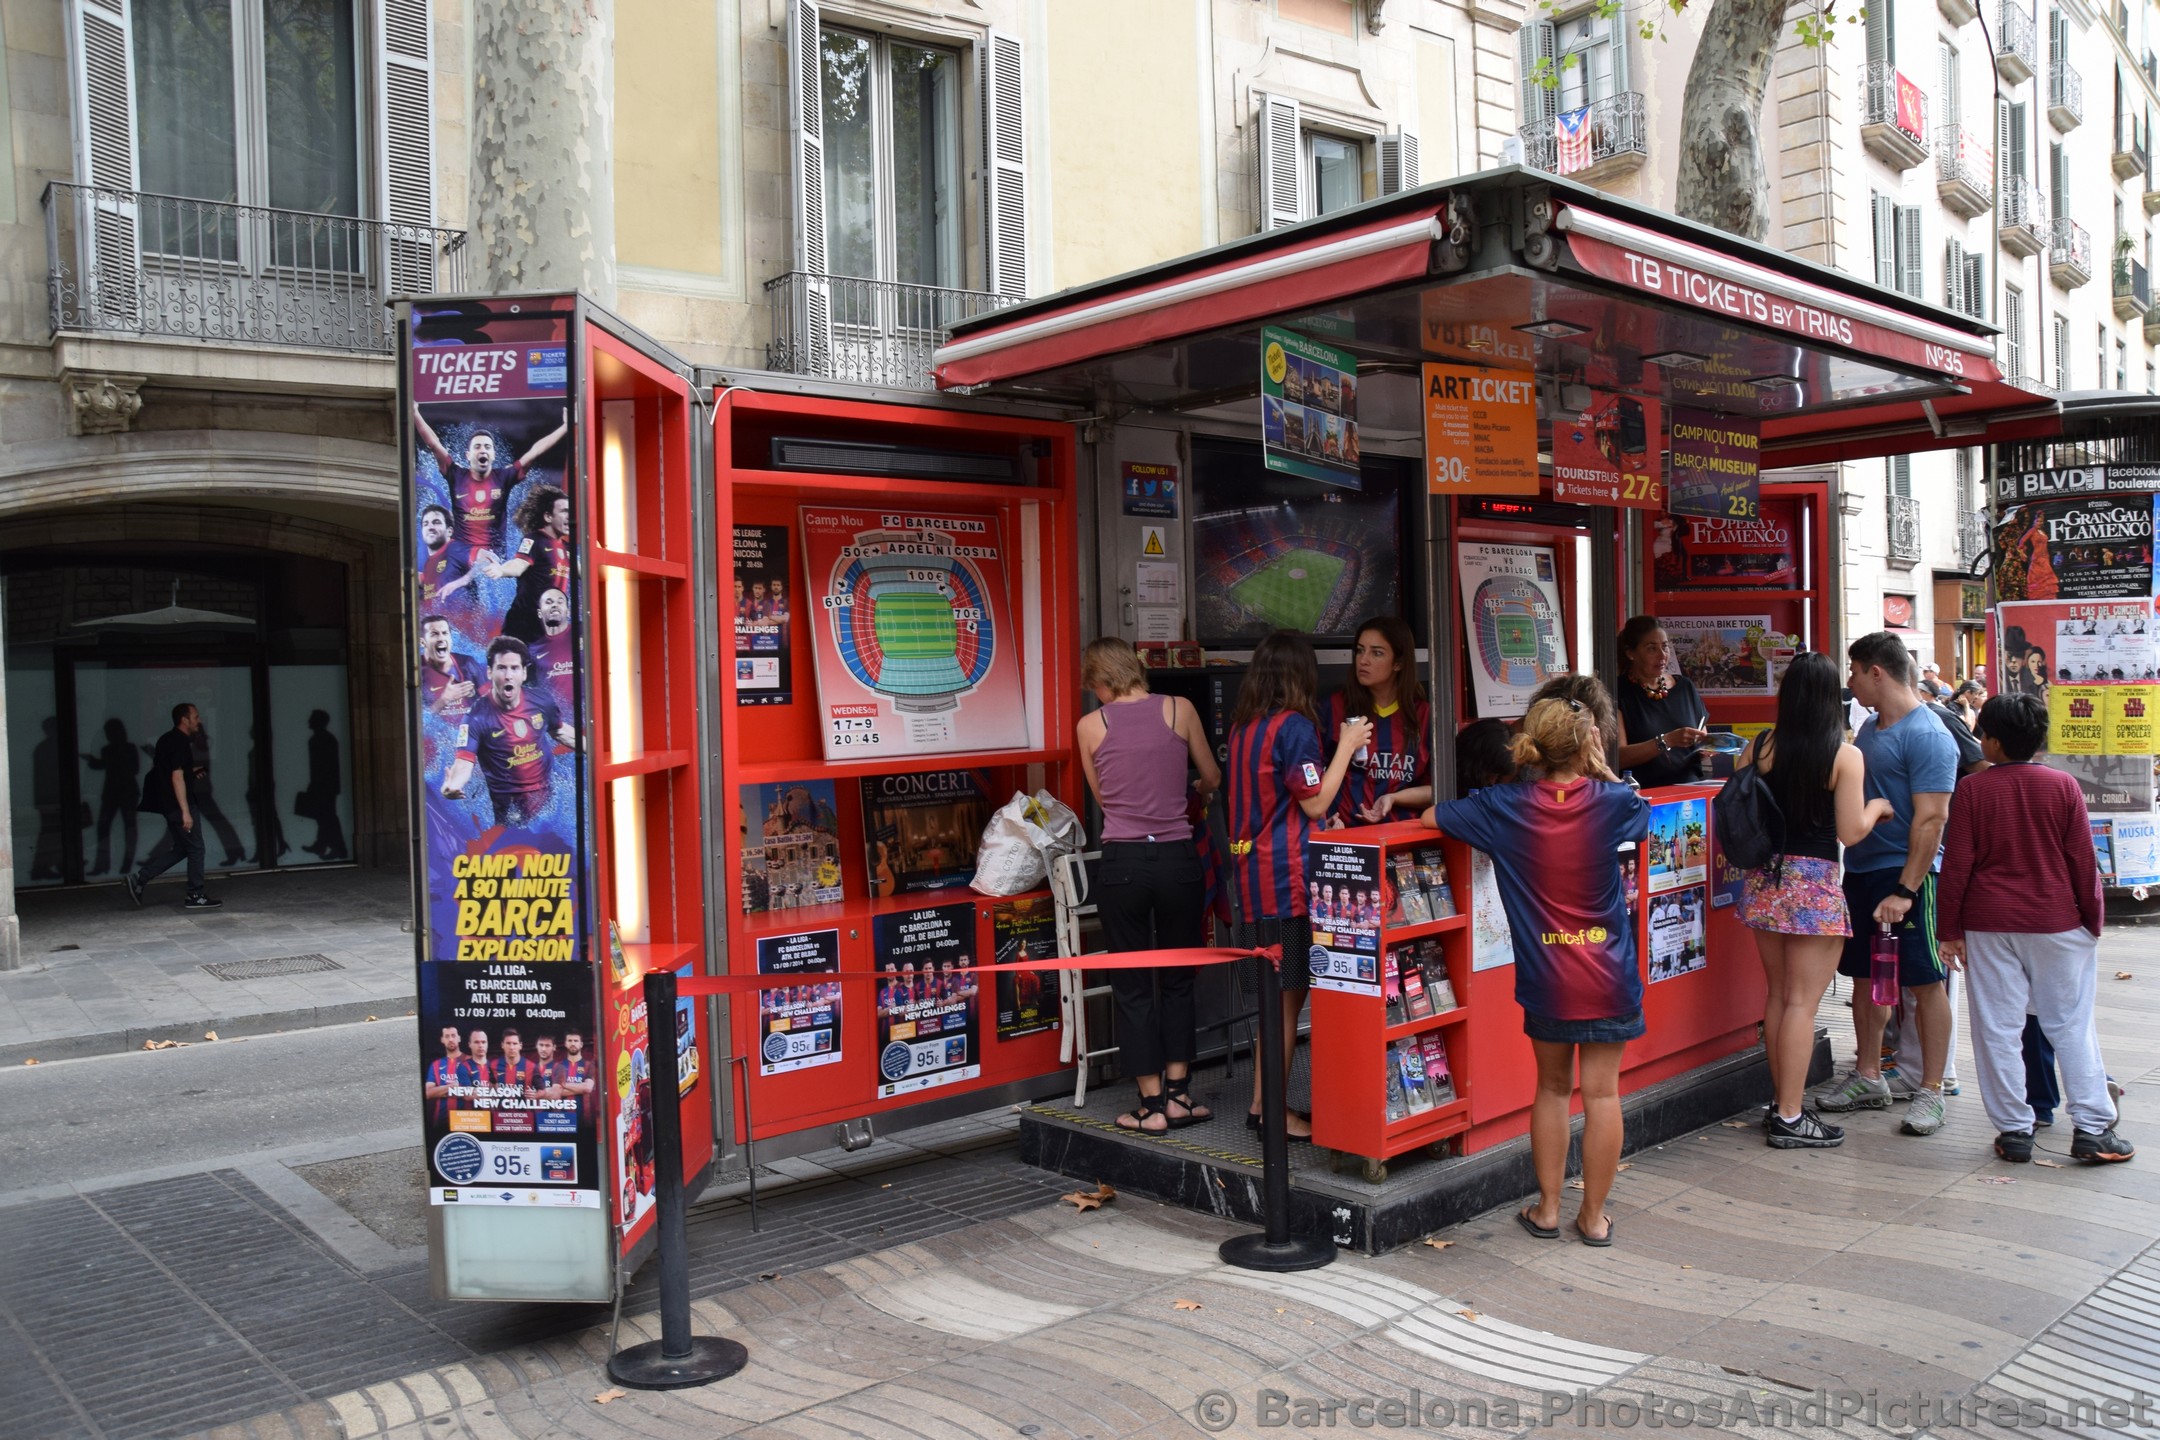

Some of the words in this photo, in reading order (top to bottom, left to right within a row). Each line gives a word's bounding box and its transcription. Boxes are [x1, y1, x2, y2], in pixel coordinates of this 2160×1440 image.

[1624, 252, 1662, 289] TB
[1666, 266, 1770, 322] TICKETS
[1771, 305, 1794, 327] BY
[1795, 305, 1853, 345] TRIAS
[542, 351, 566, 359] TICKETS
[1298, 340, 1339, 366] BARCELONA
[418, 350, 518, 374] TICKETS
[434, 374, 502, 395] HERE
[1429, 374, 1532, 405] ARTICKET
[1473, 422, 1490, 430] Museu
[1492, 423, 1511, 431] Picasso
[1446, 429, 1469, 437] Barcelona
[1474, 434, 1490, 442] MNAC
[1674, 423, 1704, 444] CAMP
[1703, 428, 1726, 446] NOU
[1727, 431, 1759, 450] TOUR
[1474, 445, 1494, 453] MACBA
[1713, 445, 1720, 454] &
[1132, 464, 1156, 474] FOLLOW
[1435, 456, 1472, 483] 30€
[1674, 452, 1709, 472] BARÇA
[1709, 457, 1758, 476] MUSEUM
[2023, 468, 2086, 493] BLVD
[2086, 467, 2095, 491] CLUB
[1567, 484, 1593, 497] Tickets
[1593, 486, 1609, 498] here
[1622, 473, 1661, 502] 27€
[2024, 487, 2057, 497] BOULEVARD
[2057, 485, 2086, 494] CULTURE
[1728, 495, 1756, 517] 23€
[806, 513, 839, 527] Camp
[841, 515, 864, 527] Nou
[2065, 511, 2112, 526] GRAN
[2111, 507, 2150, 522] GALA
[882, 516, 900, 525] FC
[906, 518, 985, 531] BARCELONA
[742, 529, 762, 538] LEAGUE
[1691, 521, 1789, 544] FLAMENCO
[2047, 518, 2151, 542] FLAMENCO
[916, 532, 936, 542] VS
[889, 543, 932, 554] APOEL
[936, 546, 997, 558] NICOSIA
[1479, 546, 1490, 555] FC
[1491, 547, 1533, 557] BARCELONA
[1503, 556, 1513, 565] VS
[908, 570, 943, 582] 100€
[1488, 565, 1503, 574] ATH
[1505, 566, 1533, 576] BILBAO
[824, 595, 853, 608] 60€
[1532, 603, 1546, 612] VIP
[954, 609, 979, 619] 70€
[2070, 606, 2077, 616] EL
[2080, 606, 2095, 616] CAS
[2098, 605, 2110, 616] DEL
[2112, 604, 2140, 616] CONCERT
[1717, 620, 1738, 628] BIKE
[1739, 619, 1764, 629] TOUR
[1760, 640, 1779, 648] bike
[832, 706, 878, 715] WEDNESday
[2061, 724, 2102, 732] CONCURSO
[2116, 724, 2152, 732] CONCURSO
[834, 732, 880, 745] 20:45
[2072, 731, 2101, 739] POLLAS
[513, 743, 537, 759] Qatar
[507, 750, 543, 769] Foundation
[1367, 768, 1414, 783] AIRWAYS
[882, 770, 970, 796] CONCERT
[2101, 790, 2131, 804] CORIOLÀ
[2118, 826, 2155, 839] MÚSICA
[1002, 839, 1023, 873] COTTON
[1334, 846, 1342, 854] LA
[1342, 847, 1353, 855] LIGA
[1321, 854, 1329, 862] FC
[1329, 855, 1358, 864] BARCELONA
[452, 853, 519, 878] CAMP
[521, 853, 571, 878] NOU
[1344, 864, 1362, 872] BILBAO
[453, 879, 468, 899] A
[471, 879, 498, 898] 90
[500, 878, 573, 898] MINUTE
[455, 899, 574, 940] BARÇA
[913, 912, 922, 921] LA
[922, 910, 936, 919] LIGA
[1312, 916, 1325, 925] NEW
[1325, 917, 1349, 927] SEASON
[899, 924, 908, 934] FC
[908, 920, 943, 933] BARCELONA
[1322, 924, 1336, 933] NEW
[1336, 926, 1376, 937] CHALLENGES
[903, 933, 917, 944] ATH.
[918, 932, 927, 941] DE
[927, 929, 949, 941] BILBAO
[1541, 928, 1586, 946] unicef
[457, 939, 575, 961] EXPLOSION
[786, 943, 814, 953] BARCELONA
[801, 950, 818, 958] BILBAO
[489, 965, 502, 975] LA
[504, 965, 527, 975] LIGA
[465, 979, 478, 990] FC
[480, 979, 538, 990] BARCELONA
[540, 981, 552, 990] vs
[471, 993, 494, 1004] ATH.
[496, 993, 509, 1004] DE
[511, 993, 547, 1004] BILBAO
[782, 1001, 806, 1012] SEASON
[794, 1005, 832, 1016] CHALLENGES
[888, 1005, 905, 1016] NEW
[906, 1000, 935, 1014] SEASON
[905, 1010, 921, 1021] NEW
[922, 1002, 967, 1019] CHALLENGES
[526, 1008, 566, 1020] 04:00pm
[618, 1072, 632, 1090] HERE
[448, 1086, 474, 1097] NEW
[476, 1086, 521, 1097] SEASON
[473, 1099, 499, 1109] NEW
[501, 1099, 577, 1110] CHALLENGES
